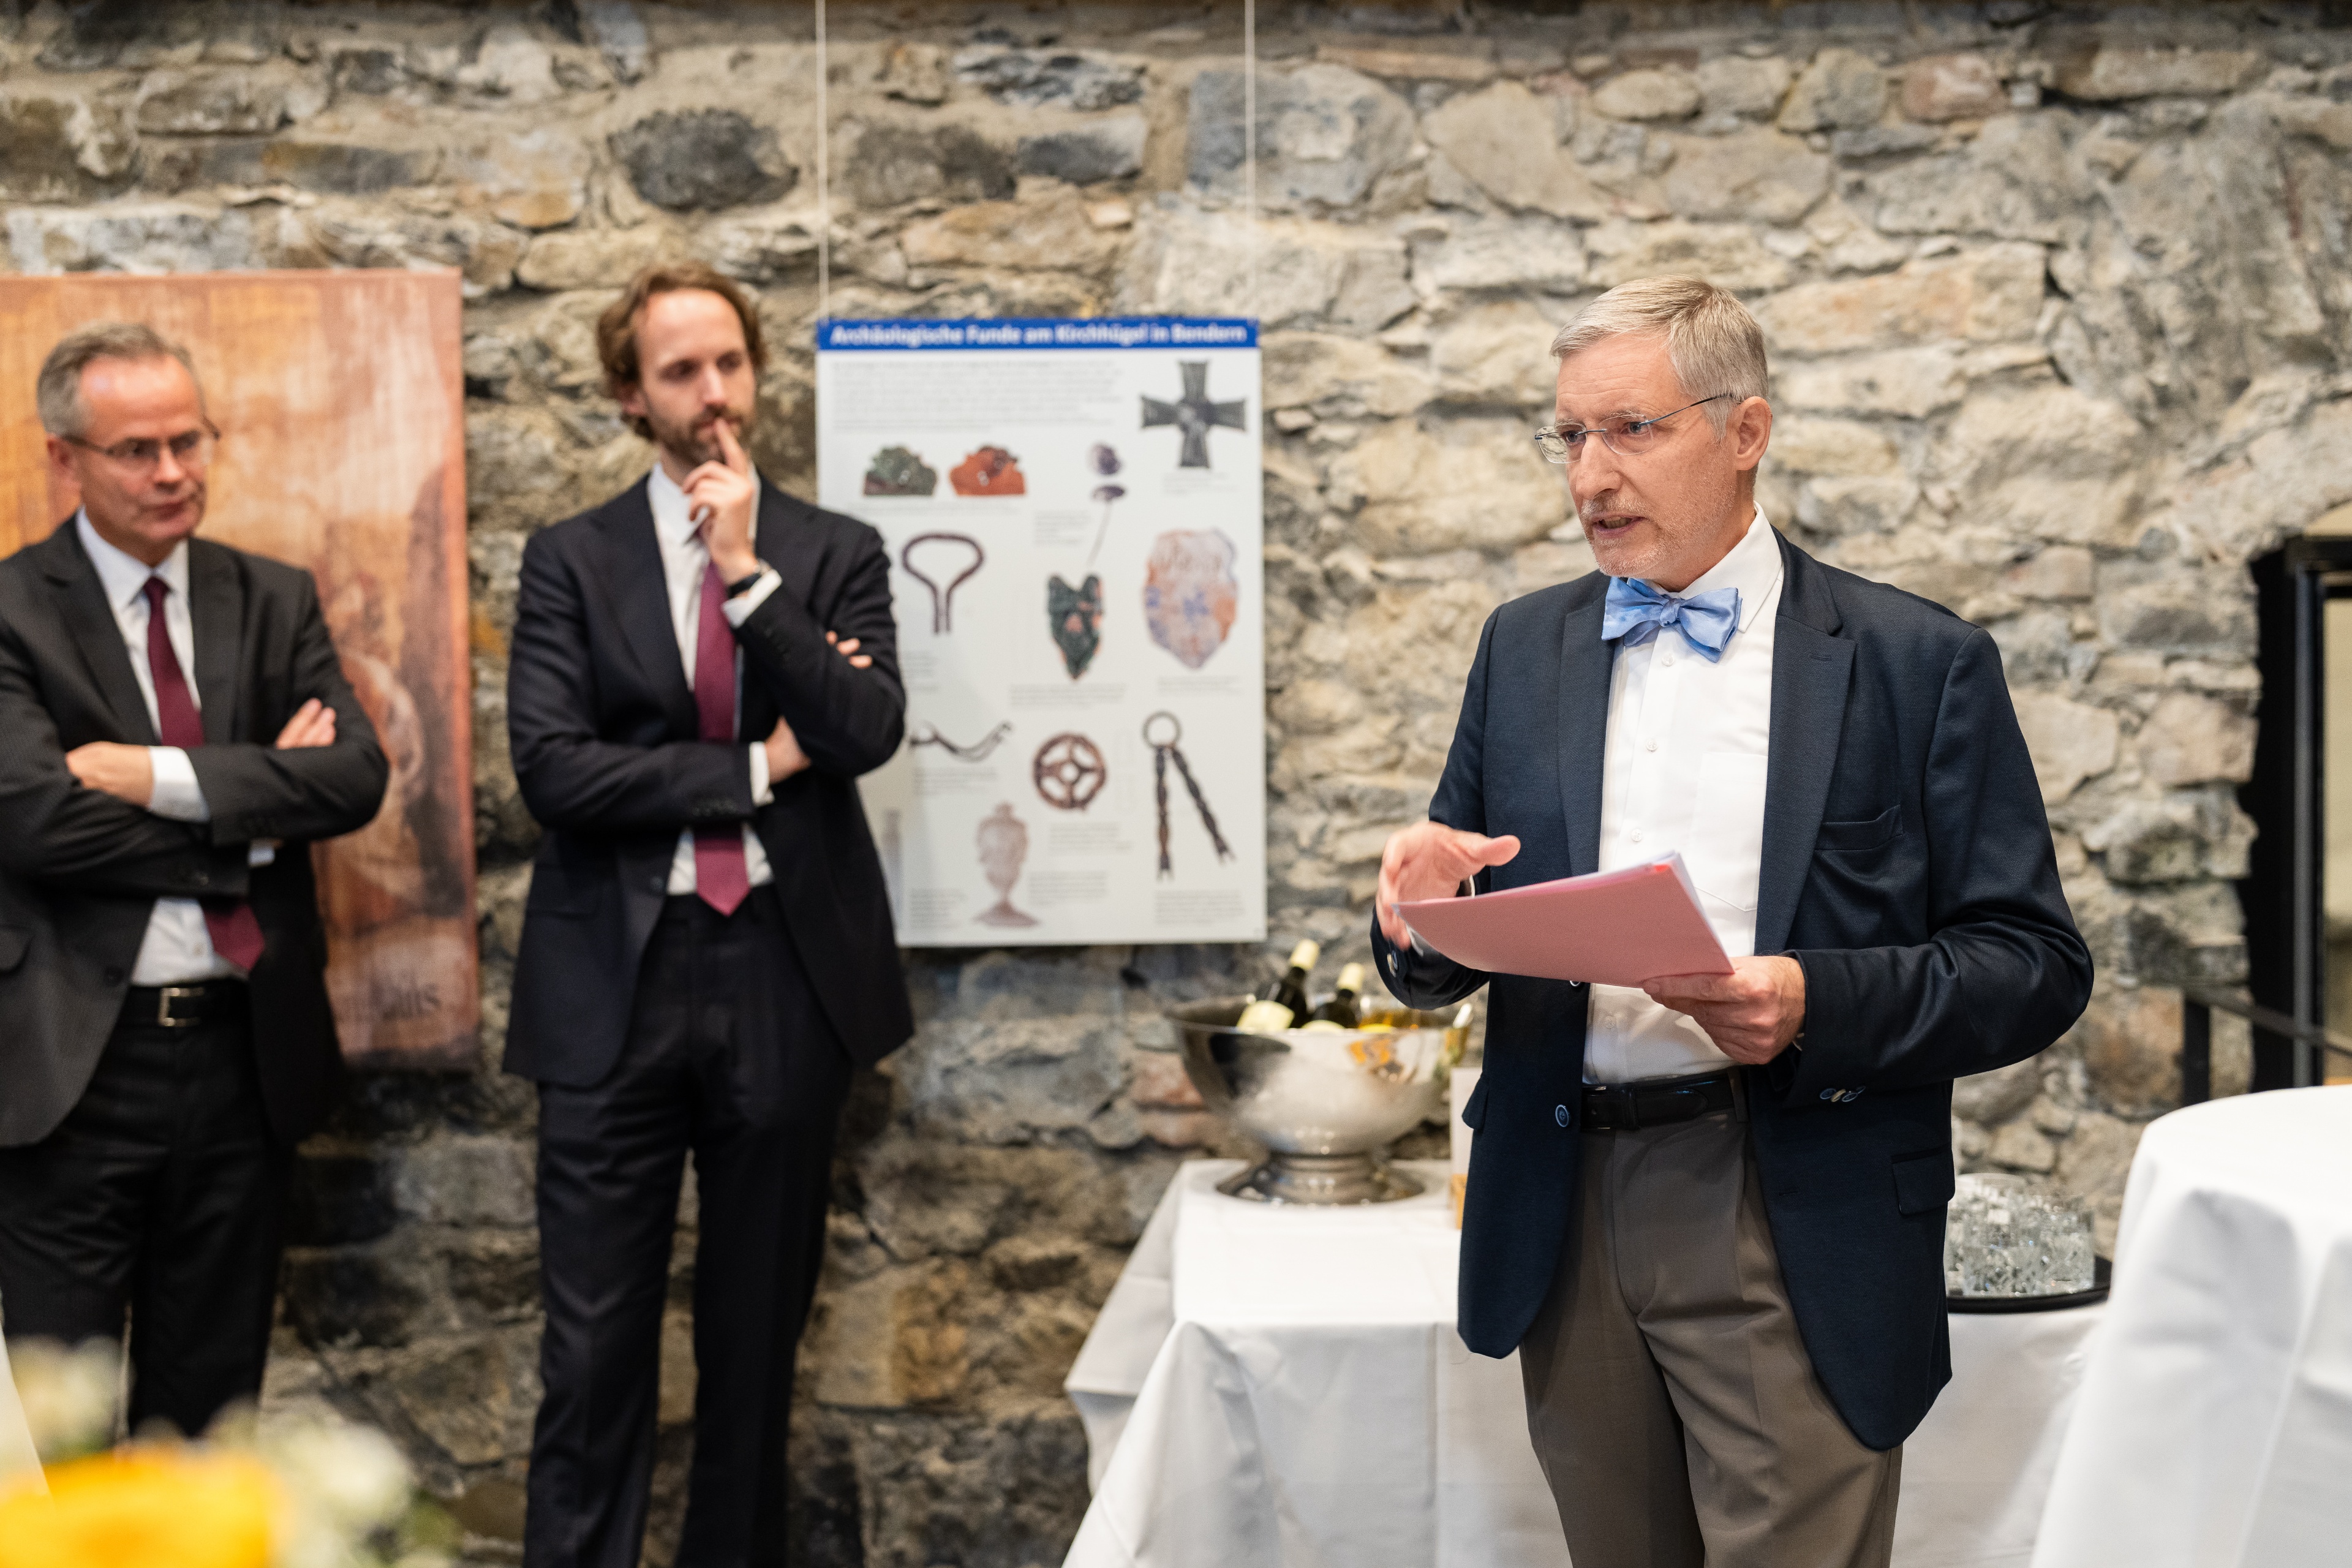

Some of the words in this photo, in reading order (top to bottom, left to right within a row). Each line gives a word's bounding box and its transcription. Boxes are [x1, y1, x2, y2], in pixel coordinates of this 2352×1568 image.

[967, 324, 1021, 344] Funde
[1024, 327, 1054, 344] am
[1151, 323, 1169, 343] in
